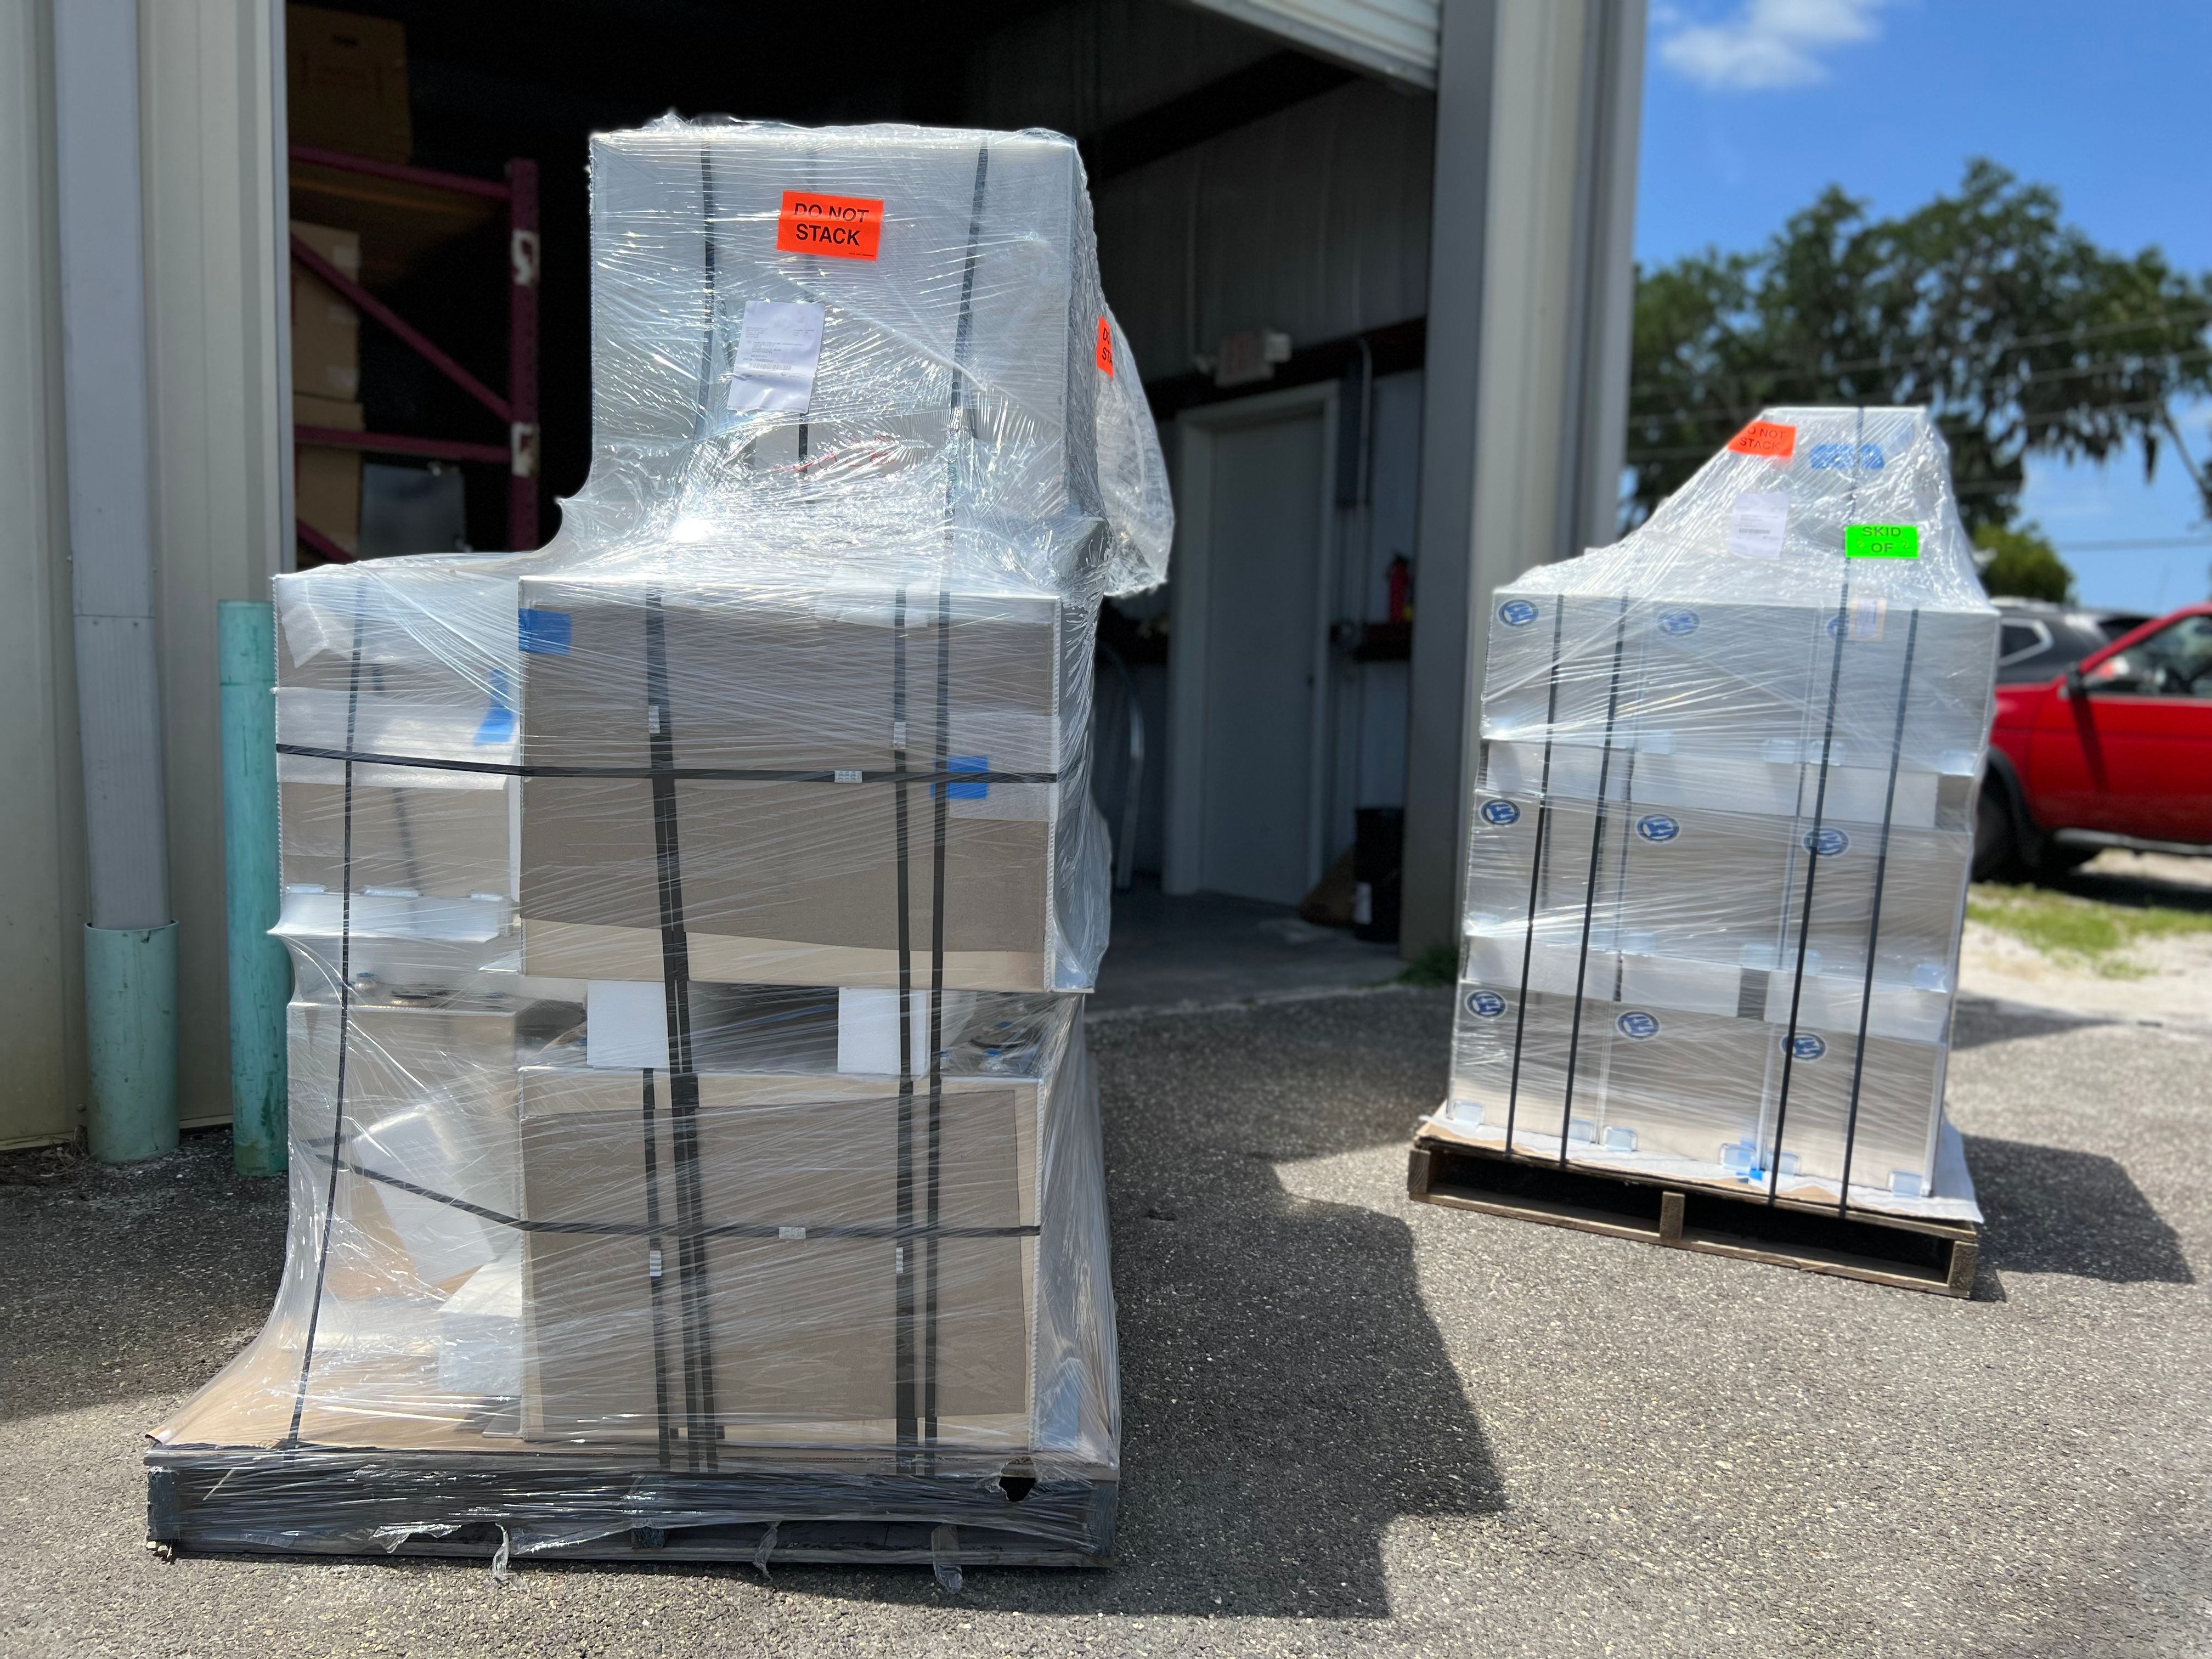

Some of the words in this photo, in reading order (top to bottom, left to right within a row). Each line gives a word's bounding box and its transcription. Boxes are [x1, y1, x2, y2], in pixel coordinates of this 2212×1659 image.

[794, 203, 822, 217] DO
[828, 206, 869, 223] NOT
[796, 223, 861, 246] STACK
[1102, 347, 1113, 366] STA
[1748, 426, 1756, 435] O
[1759, 428, 1786, 439] NOT
[1740, 437, 1780, 450] STACK
[1862, 527, 1901, 537] SKID
[1871, 543, 1894, 553] OF
